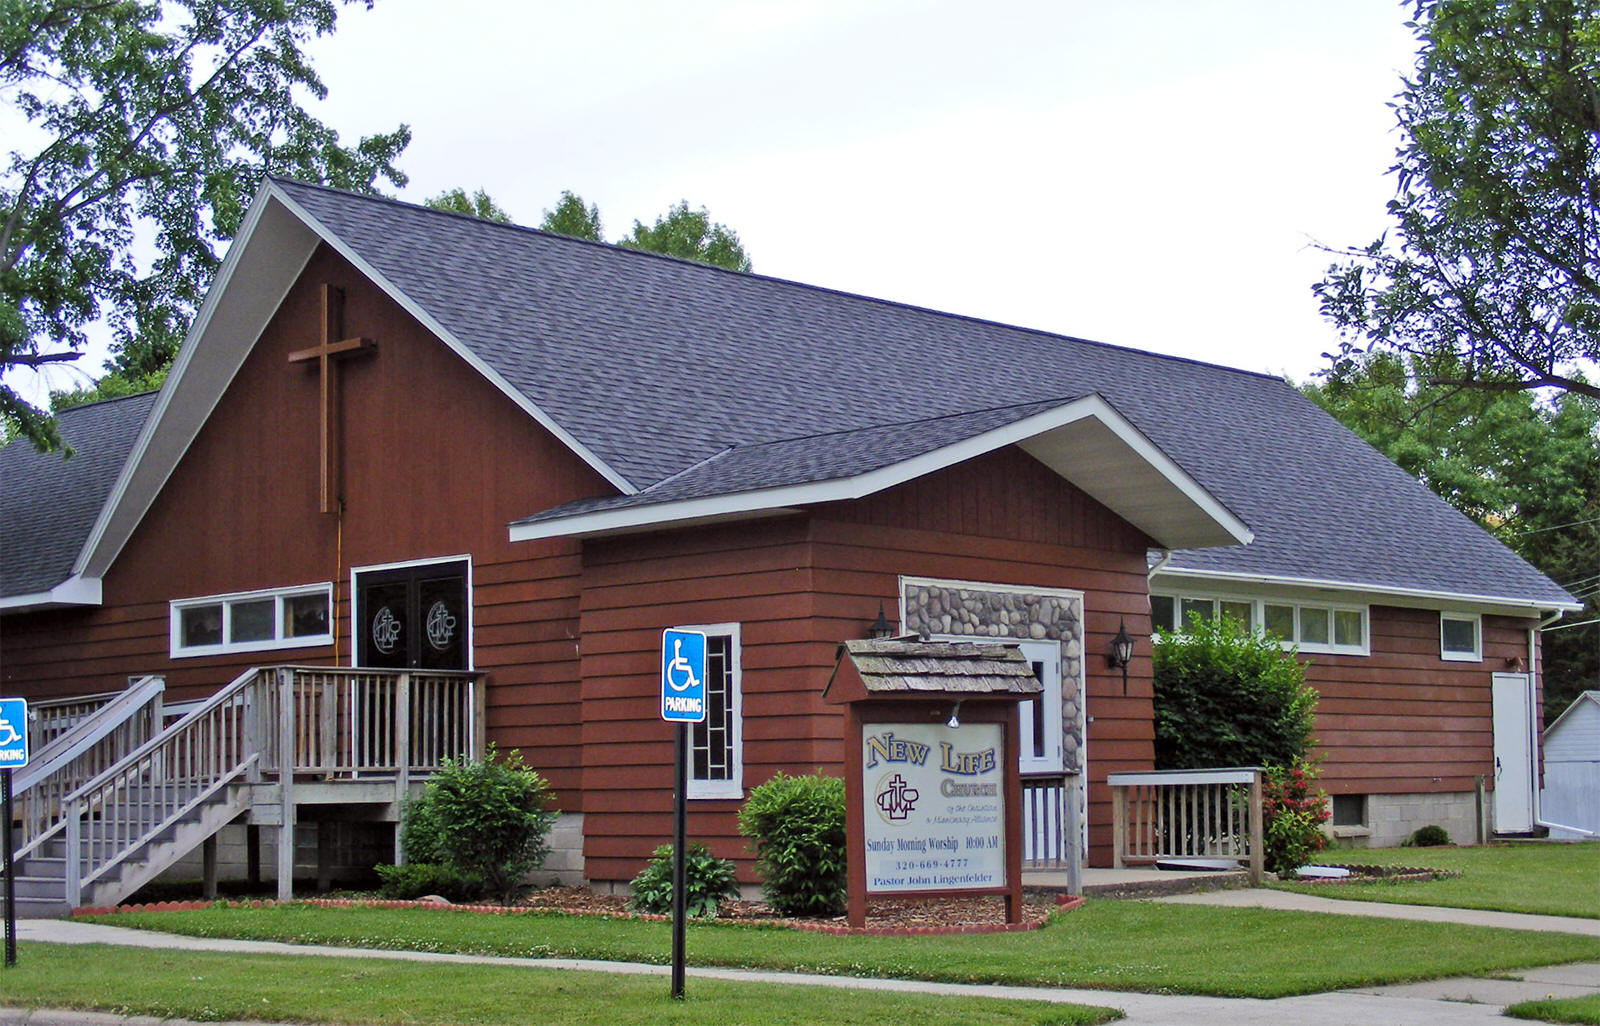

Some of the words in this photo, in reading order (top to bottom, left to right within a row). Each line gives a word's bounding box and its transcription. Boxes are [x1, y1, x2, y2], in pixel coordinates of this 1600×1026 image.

[665, 697, 702, 713] PARKING
[867, 837, 894, 854] Sunday
[897, 836, 927, 854] Morning
[928, 835, 959, 853] Worship
[966, 836, 985, 849] 10:00
[986, 835, 998, 849] AM
[895, 858, 969, 871] 320-669-4777
[873, 877, 905, 886] Pastor
[907, 876, 931, 885] John
[933, 873, 993, 885] Lingenfelder
